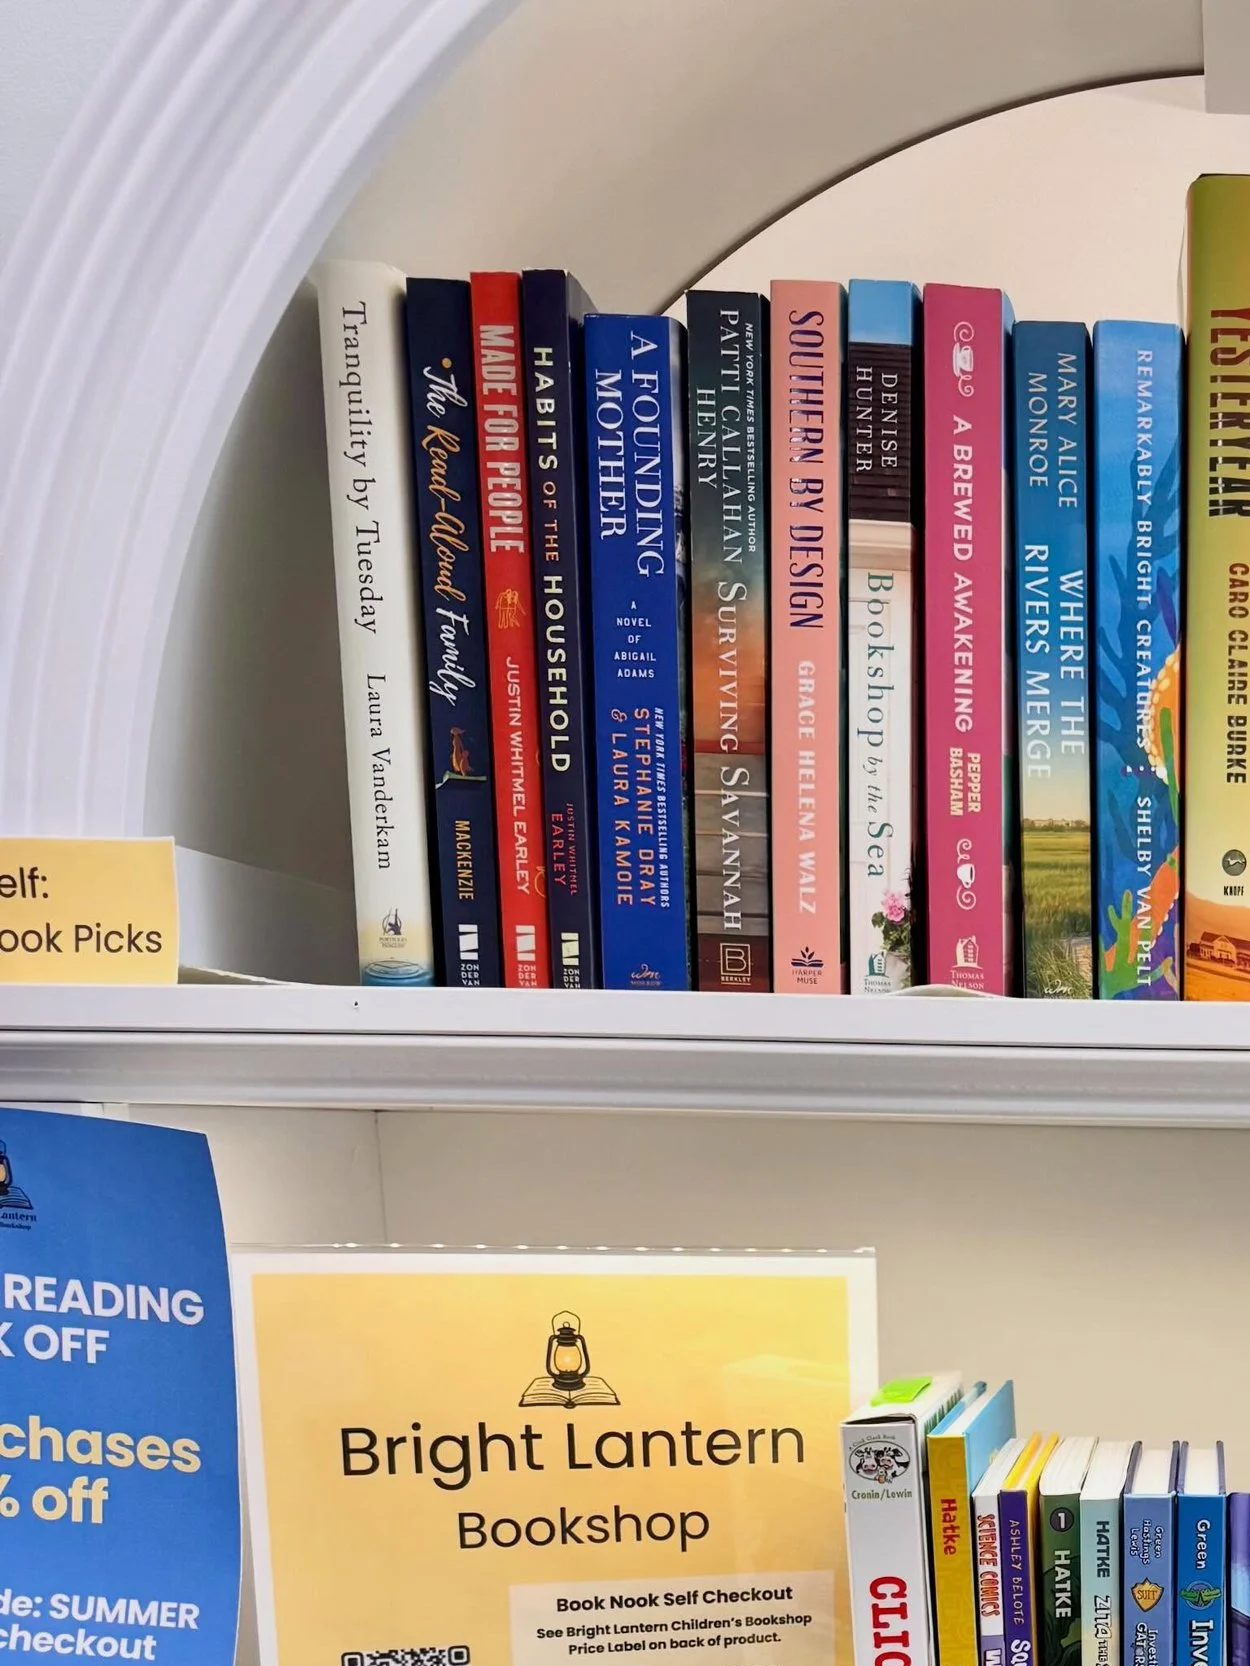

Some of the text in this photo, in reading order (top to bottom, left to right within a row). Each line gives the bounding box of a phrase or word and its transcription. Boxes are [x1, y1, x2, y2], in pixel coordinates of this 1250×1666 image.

[479, 324, 525, 553] MADE FOR PEOPLE
[696, 387, 717, 489] HENRY
[720, 309, 743, 566] PATTI CALLAHAN
[855, 365, 873, 473] HUNTER
[881, 372, 898, 468] DENISE
[595, 369, 627, 540] MOTHER
[631, 331, 665, 578] A FOUNDING
[788, 309, 825, 629] SOUTHERN BY DESIGN
[338, 301, 395, 870] Tranquility by Tuesday Laura Vanderkam
[953, 415, 974, 733] A BREWED AWAKENING
[613, 651, 657, 662] ABIGAIL
[616, 668, 655, 679] ADAMS
[857, 572, 895, 878] Bookshop by the Sea
[0, 922, 163, 954] ook Picks
[4, 1273, 205, 1326] READING
[23, 1323, 110, 1364] OFF
[340, 1418, 805, 1491] Bright Lantern
[32, 1475, 110, 1525] off
[851, 1488, 913, 1501] Cronin/Lewin
[457, 1504, 711, 1553] Bookshop
[50, 1593, 200, 1631] SUMMER
[556, 1585, 793, 1612] Book Nook Self Checkout
[1053, 1549, 1072, 1619] HATKE
[1136, 1587, 1159, 1602] SUIT
[535, 1612, 812, 1640] See Bright Lantern Children's Bookshop
[568, 1631, 782, 1655] Price Label on back of product.
